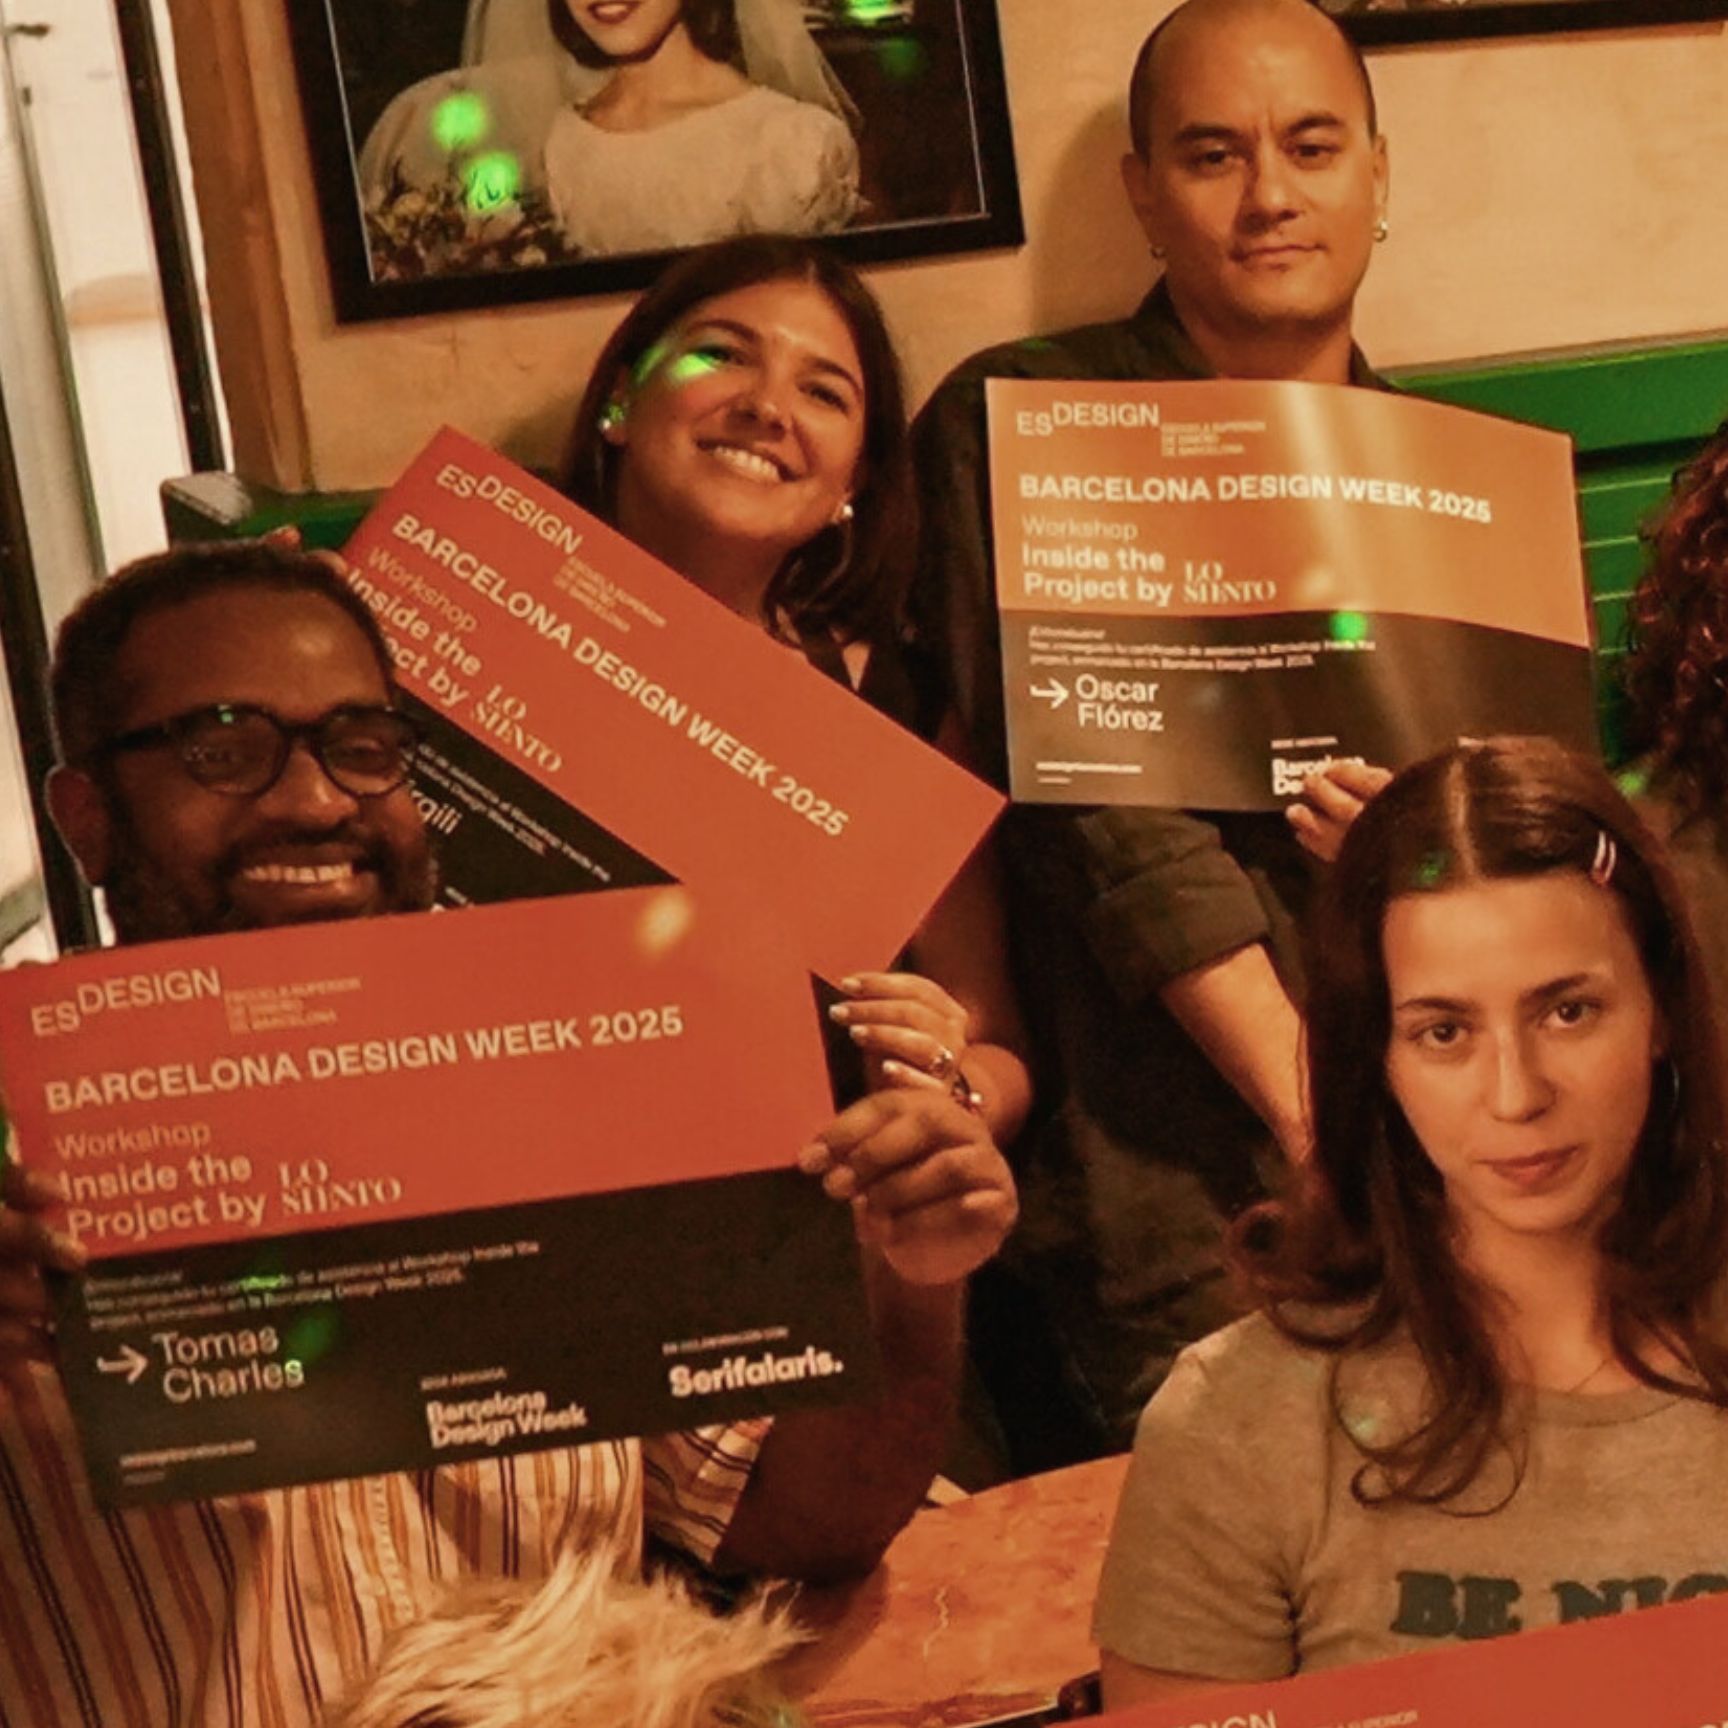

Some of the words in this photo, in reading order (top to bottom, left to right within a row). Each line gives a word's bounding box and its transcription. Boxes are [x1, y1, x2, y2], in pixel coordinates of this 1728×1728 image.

[1014, 400, 1160, 437] ESDESIGN
[436, 464, 584, 573] ESDESIGN
[1019, 473, 1211, 502] BARCELONA
[1218, 473, 1337, 505] DESIGN
[1338, 476, 1425, 510] WEEK
[1427, 488, 1493, 524] 2025
[392, 514, 572, 650] BARCELONA
[573, 637, 688, 726] DESIGN
[687, 713, 776, 787] WEEK
[771, 775, 849, 836] 2025
[1074, 673, 1159, 704] Oscar
[1077, 701, 1164, 732] Flórez
[31, 965, 230, 1036] ESDESIGN
[45, 1052, 302, 1112] BARCELONA
[308, 1033, 458, 1079] DESIGN
[464, 1018, 582, 1060] WEEK
[589, 1005, 683, 1045] 2025
[163, 1358, 305, 1403] Charles
[669, 1345, 844, 1397] Serifalaris.
[1391, 1570, 1522, 1639] BE
